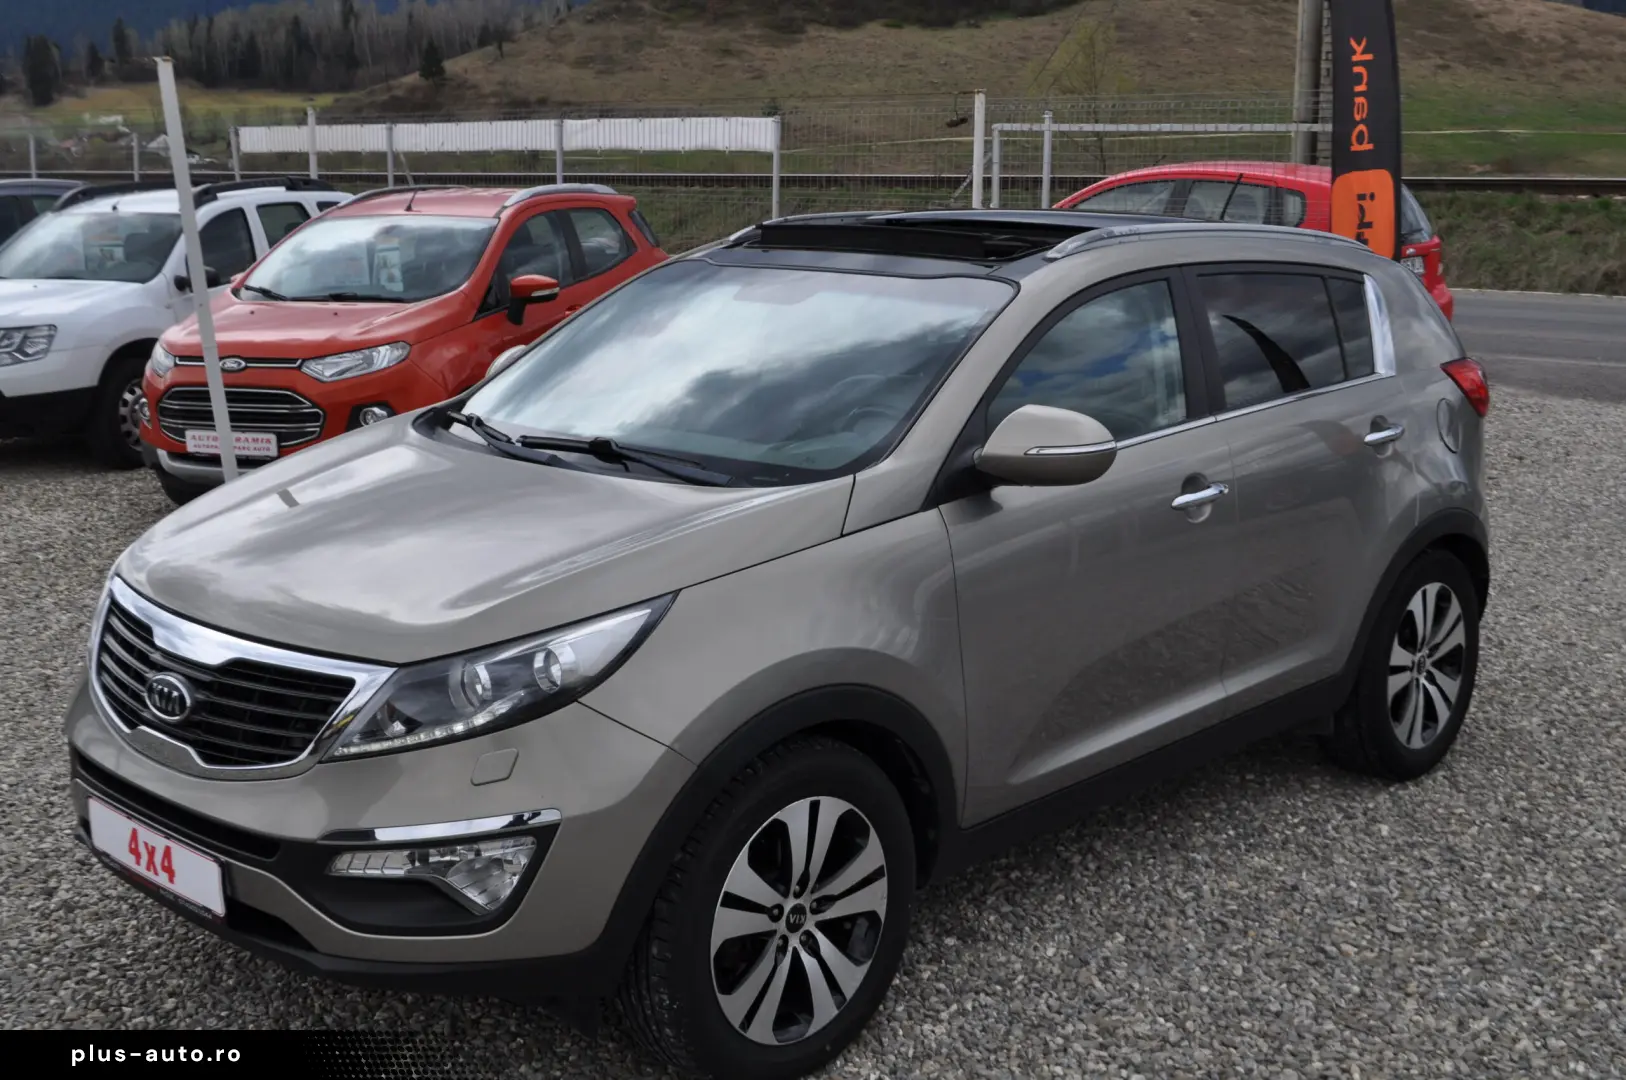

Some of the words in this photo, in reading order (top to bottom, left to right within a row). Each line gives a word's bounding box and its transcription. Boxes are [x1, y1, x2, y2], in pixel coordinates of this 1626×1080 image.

[151, 682, 180, 715] KIA
[128, 827, 176, 885] 4x4
[790, 914, 806, 924] KIA
